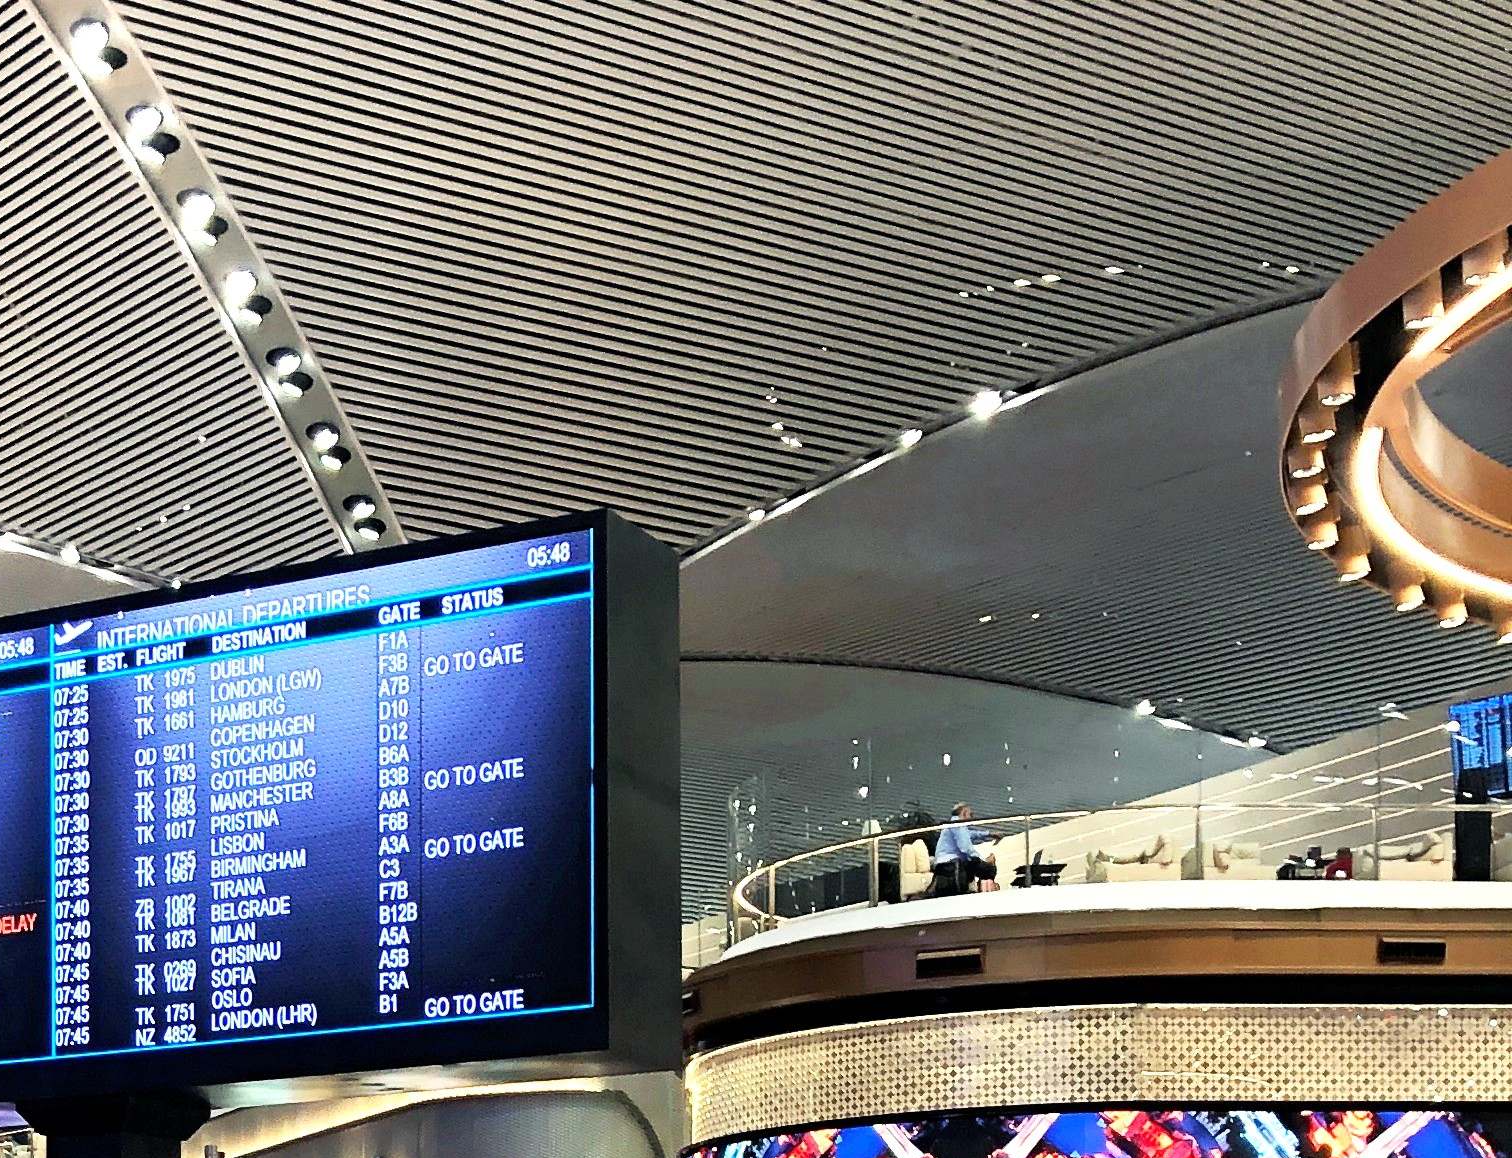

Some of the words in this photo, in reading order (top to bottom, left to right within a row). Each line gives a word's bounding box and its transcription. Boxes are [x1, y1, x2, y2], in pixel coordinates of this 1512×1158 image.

[527, 542, 571, 567] 05:48
[97, 611, 235, 650] INTERNATIONAL
[242, 585, 371, 625] DEPARTURES
[55, 659, 86, 680] TIME
[97, 653, 128, 673] EST.
[136, 642, 186, 667] FLIGHT
[211, 621, 306, 653] DESTINATION
[378, 601, 421, 625] GATE
[442, 587, 504, 614] STATUS
[378, 630, 408, 652] F1A
[210, 655, 265, 681] DUBLIN
[378, 653, 408, 675] F3B
[424, 655, 450, 677] GO
[453, 651, 476, 672] TO
[479, 643, 524, 668] GATE
[135, 674, 154, 693] TK
[164, 667, 196, 688] 1975
[210, 676, 273, 703] LONDON
[276, 667, 322, 697] (LGW)
[378, 676, 410, 698] A7B
[54, 684, 89, 707] 07:25
[210, 697, 286, 725] HAMBURG
[378, 698, 408, 721] D10
[54, 728, 89, 750] 07:30
[210, 713, 315, 747] COPENHAGEN
[378, 721, 408, 743] D12
[135, 748, 157, 767] OD
[163, 742, 195, 764] 9211
[210, 738, 304, 769] STOCKHOLM
[378, 744, 410, 766] B6A
[54, 771, 89, 792] 07:30
[210, 759, 317, 791] GOTHENBURG
[378, 766, 409, 788] B3B
[424, 770, 450, 791] GO
[453, 765, 476, 786] TO
[479, 758, 524, 783] GATE
[210, 781, 314, 813] MANCHESTER
[378, 789, 410, 810] A8A
[210, 808, 279, 835] PRISTINA
[378, 811, 408, 833] F6B
[55, 835, 89, 855] 07:35
[210, 832, 265, 857] LISBON
[378, 834, 410, 856] A3A
[424, 837, 450, 858] GO
[453, 834, 476, 854] TO
[479, 827, 524, 851] GATE
[210, 848, 306, 879] BIRMINGHAM
[379, 858, 400, 879] C3
[210, 876, 266, 901] TIRANA
[379, 881, 409, 902] F7B
[55, 899, 89, 920] 07:40
[210, 896, 291, 923] BELGRADE
[379, 902, 418, 924] B12B
[135, 934, 155, 953] TK
[164, 929, 196, 949] 1873
[210, 921, 256, 944] MILAN
[378, 926, 410, 947] A5A
[210, 941, 282, 967] CHISINAU
[378, 948, 409, 969] A5B
[55, 964, 89, 983] 07:45
[210, 966, 256, 989] SOFIA
[379, 971, 409, 991] F3A
[211, 988, 253, 1010] OSLO
[379, 994, 397, 1014] B1
[424, 997, 450, 1018] GO
[453, 994, 476, 1015] TO
[479, 988, 524, 1012] GATE
[55, 1006, 89, 1026] 07:45
[135, 1007, 155, 1026] TK
[164, 1003, 195, 1023] 1751
[211, 1008, 274, 1032] LONDON
[277, 1003, 317, 1028] (LHR)
[55, 1028, 89, 1047] 07:45
[135, 1028, 156, 1046] NZ
[163, 1024, 196, 1044] 4852
